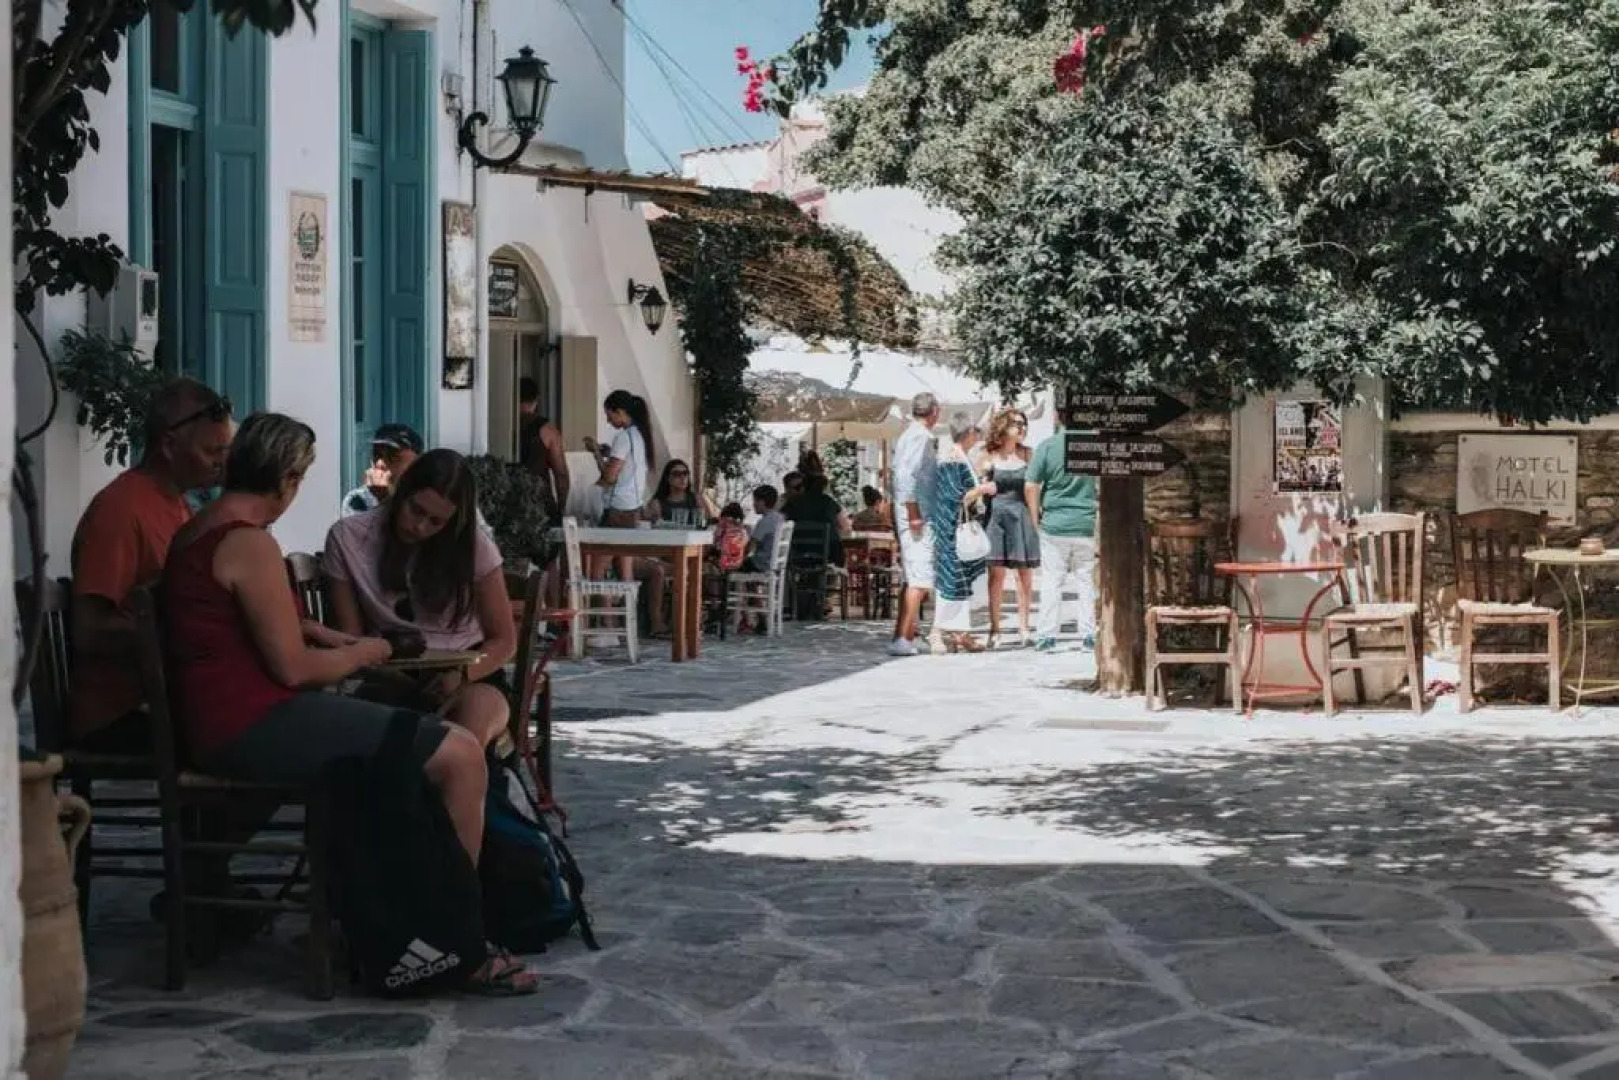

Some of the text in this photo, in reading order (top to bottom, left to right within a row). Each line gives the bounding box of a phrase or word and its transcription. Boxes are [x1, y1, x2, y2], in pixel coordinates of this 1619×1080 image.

[1496, 456, 1569, 474] MOTEL
[1496, 476, 1566, 500] HALKI
[385, 952, 460, 988] adidas
